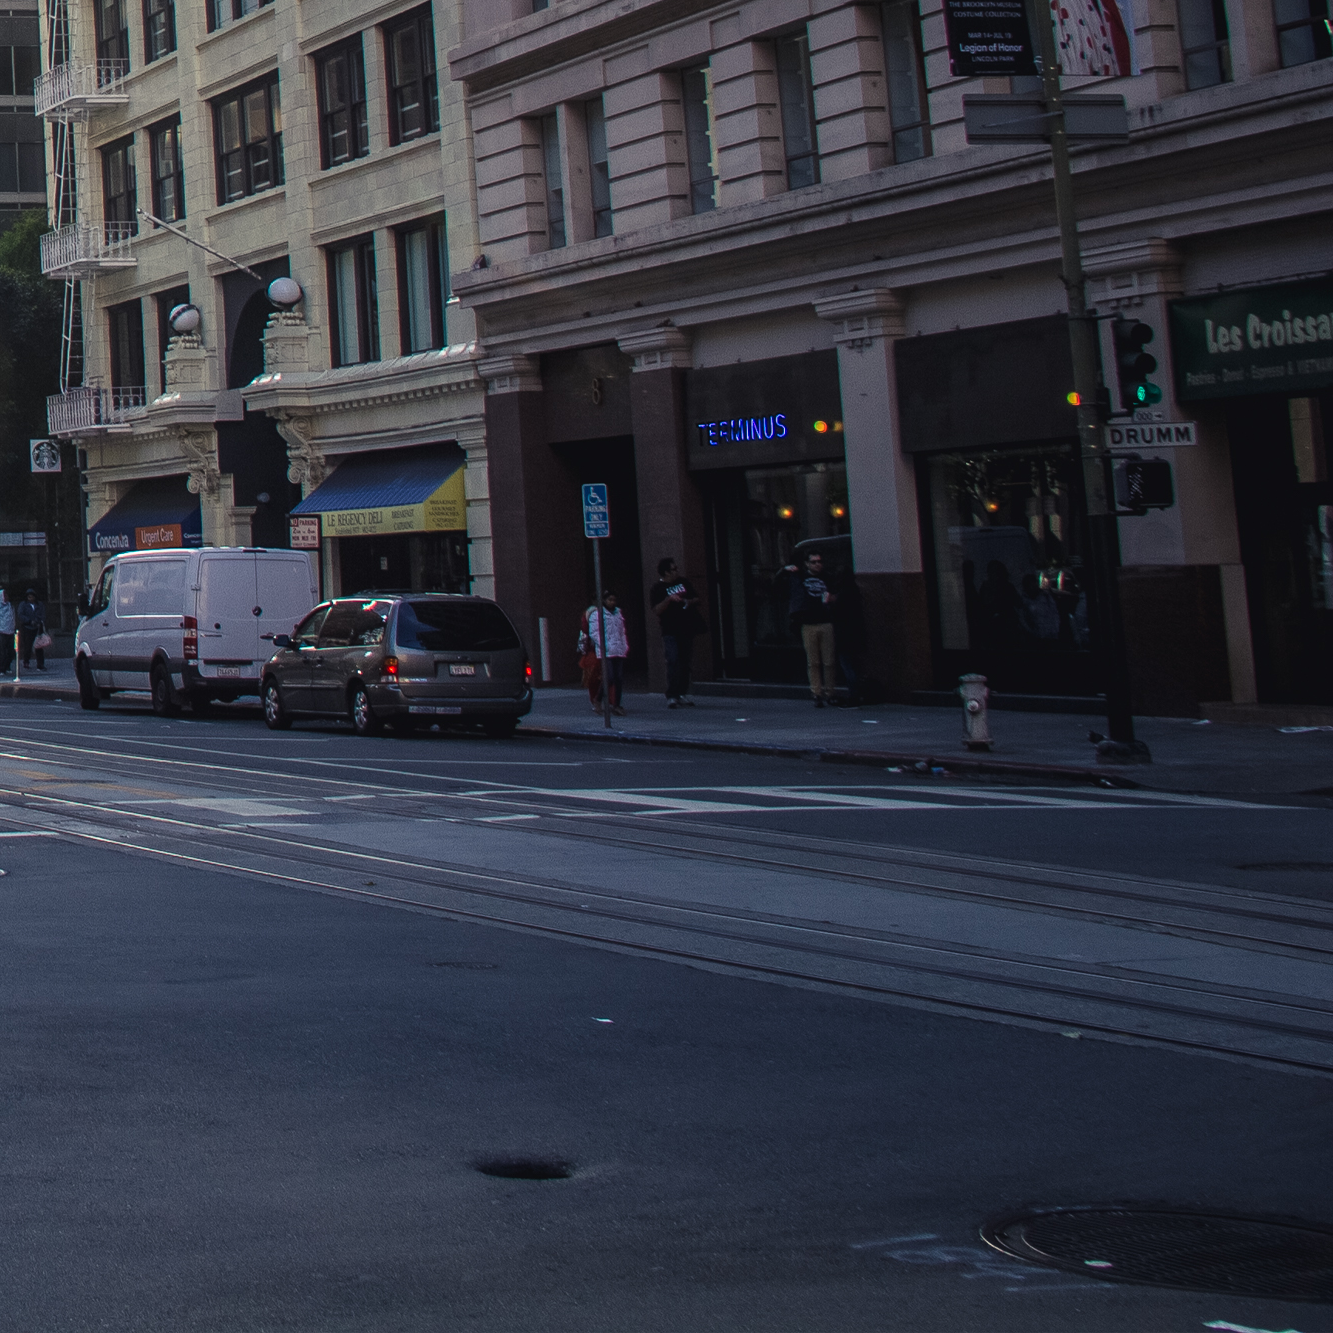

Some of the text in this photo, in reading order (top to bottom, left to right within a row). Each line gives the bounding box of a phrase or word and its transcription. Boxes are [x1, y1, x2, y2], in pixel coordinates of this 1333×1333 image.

[959, 43, 1023, 55] Legion of Honor
[1204, 319, 1243, 354] Les
[592, 378, 600, 405] 8
[696, 413, 788, 446] TERMINUS
[1110, 426, 1191, 445] DRUMM
[327, 511, 383, 527] LE REGENCY DELI
[95, 528, 174, 550] Concentra Urgent Care
